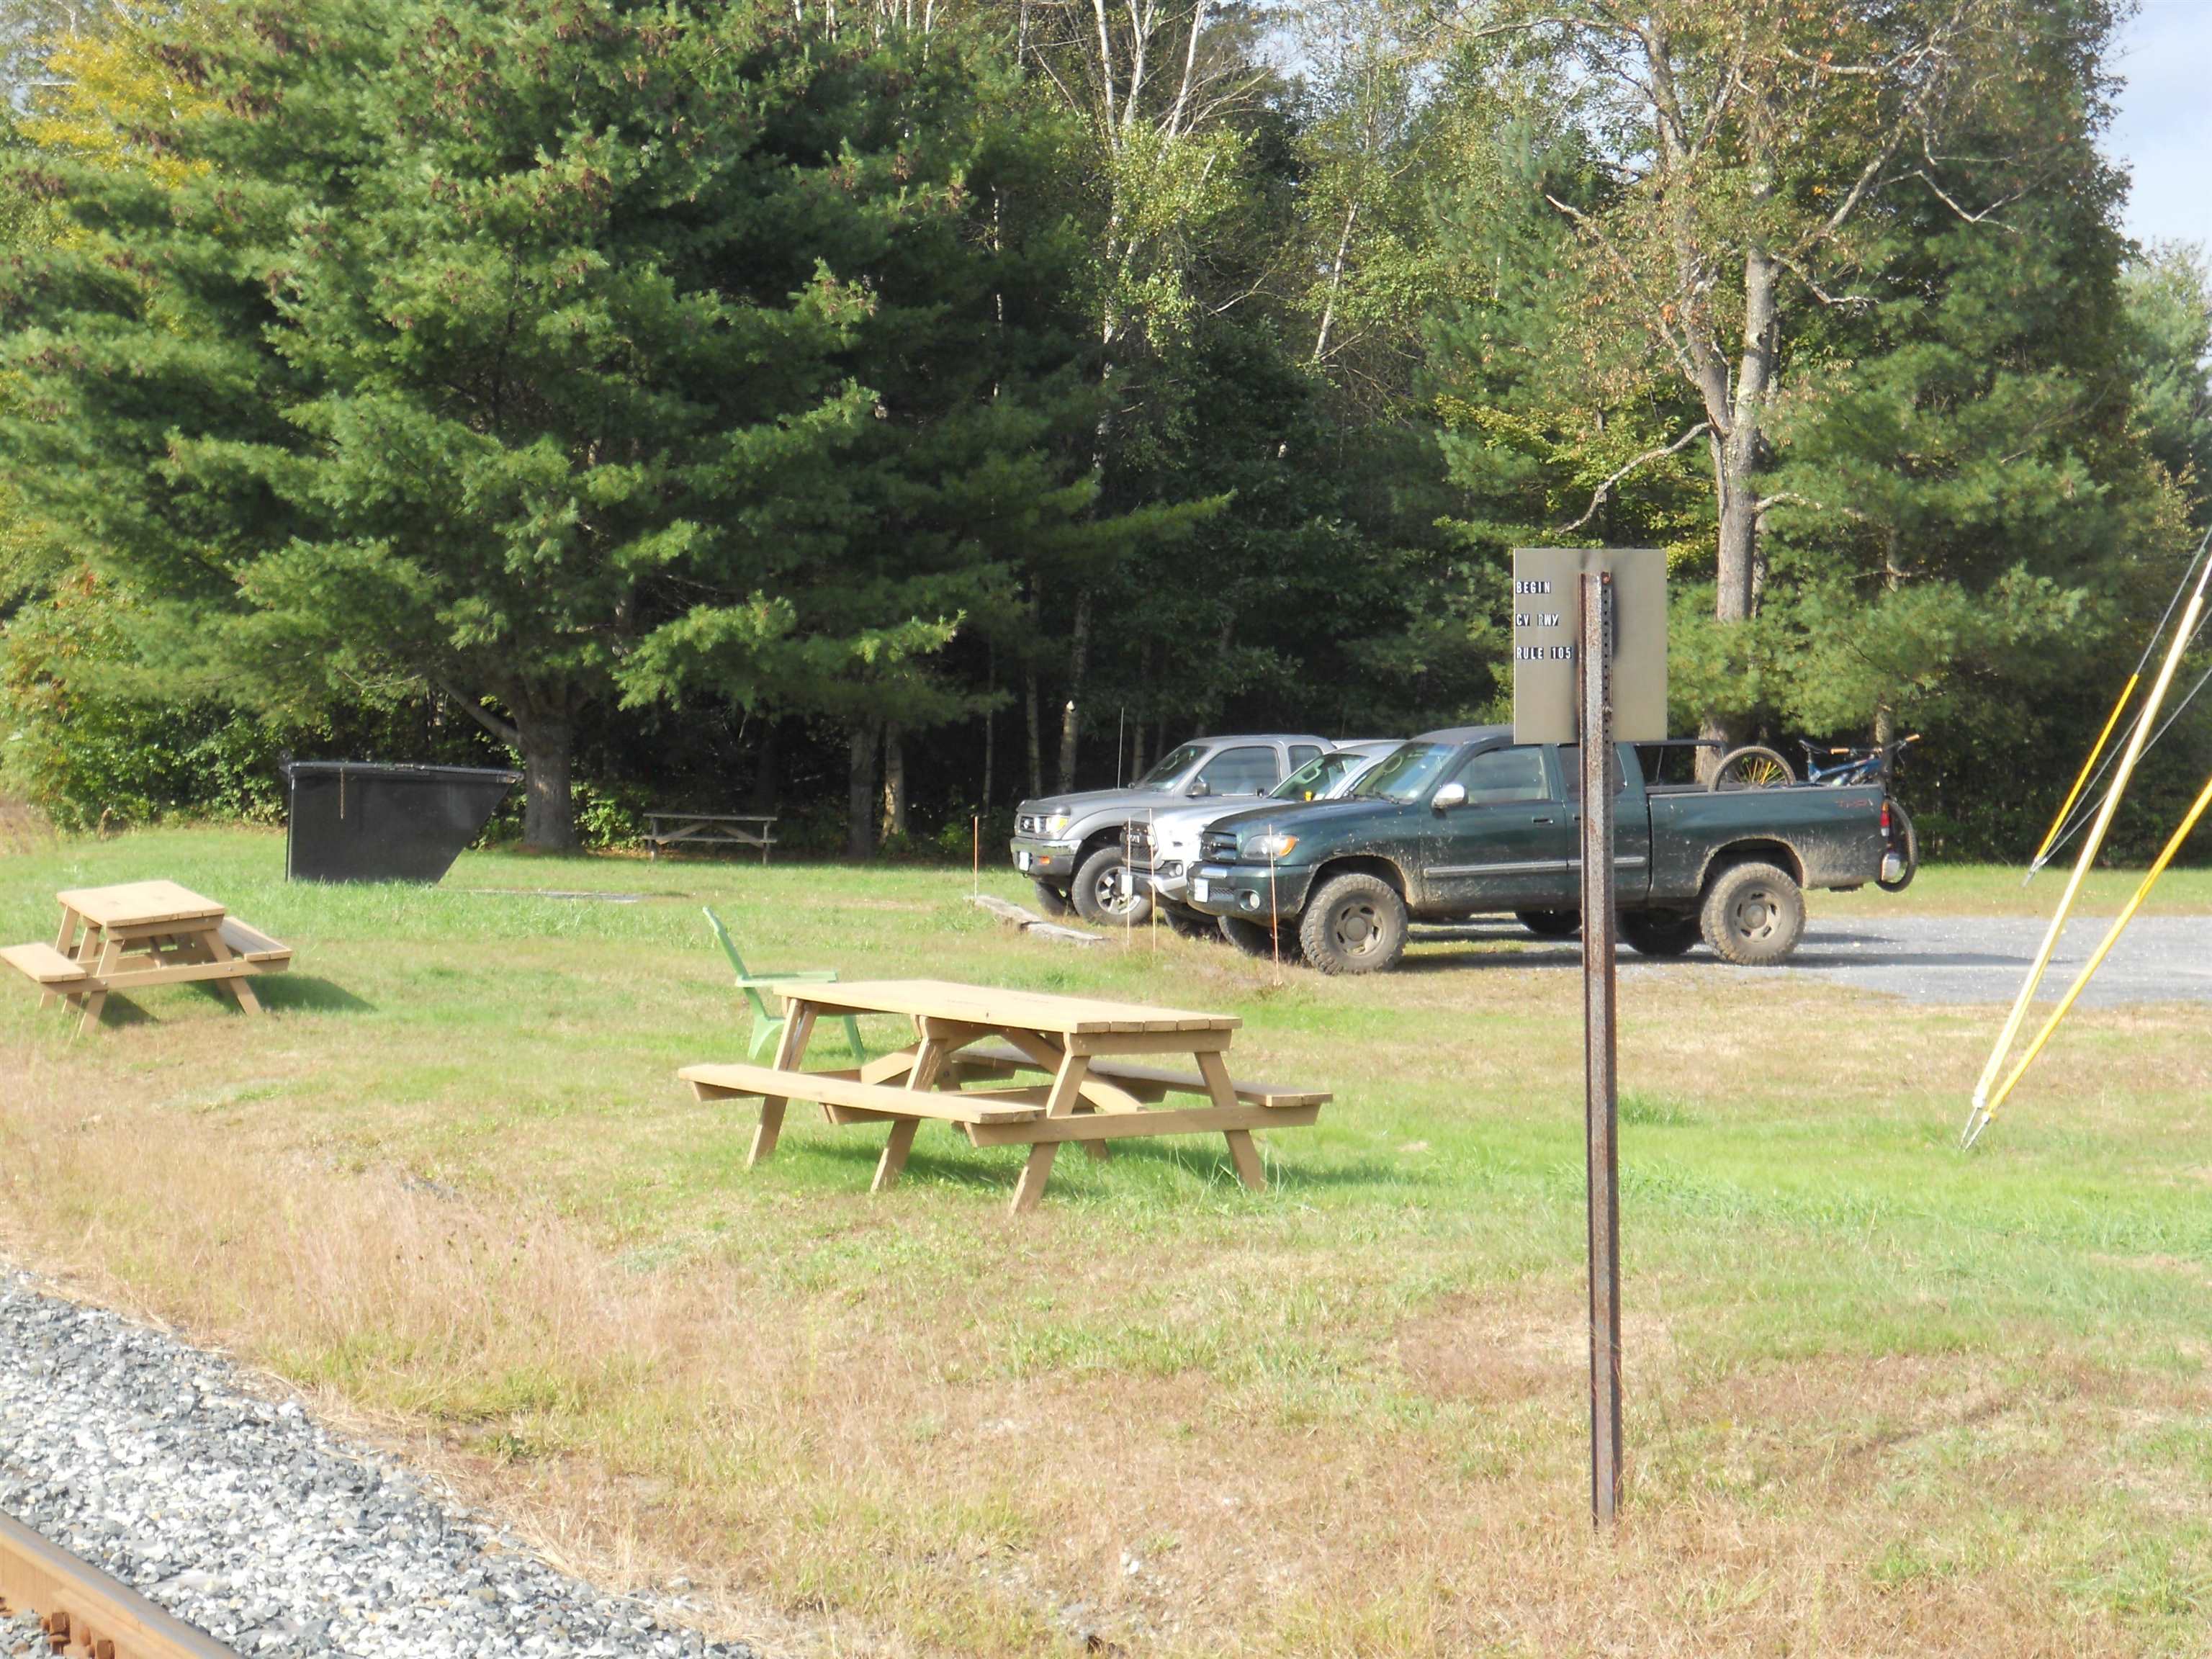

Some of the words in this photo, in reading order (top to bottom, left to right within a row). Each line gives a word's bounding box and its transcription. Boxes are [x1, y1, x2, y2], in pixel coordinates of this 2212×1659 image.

[1516, 582, 1550, 593] BEGIN
[1516, 613, 1529, 626] CV
[1537, 613, 1558, 626] RWY
[1516, 647, 1543, 659] RULE
[1551, 647, 1572, 659] 105
